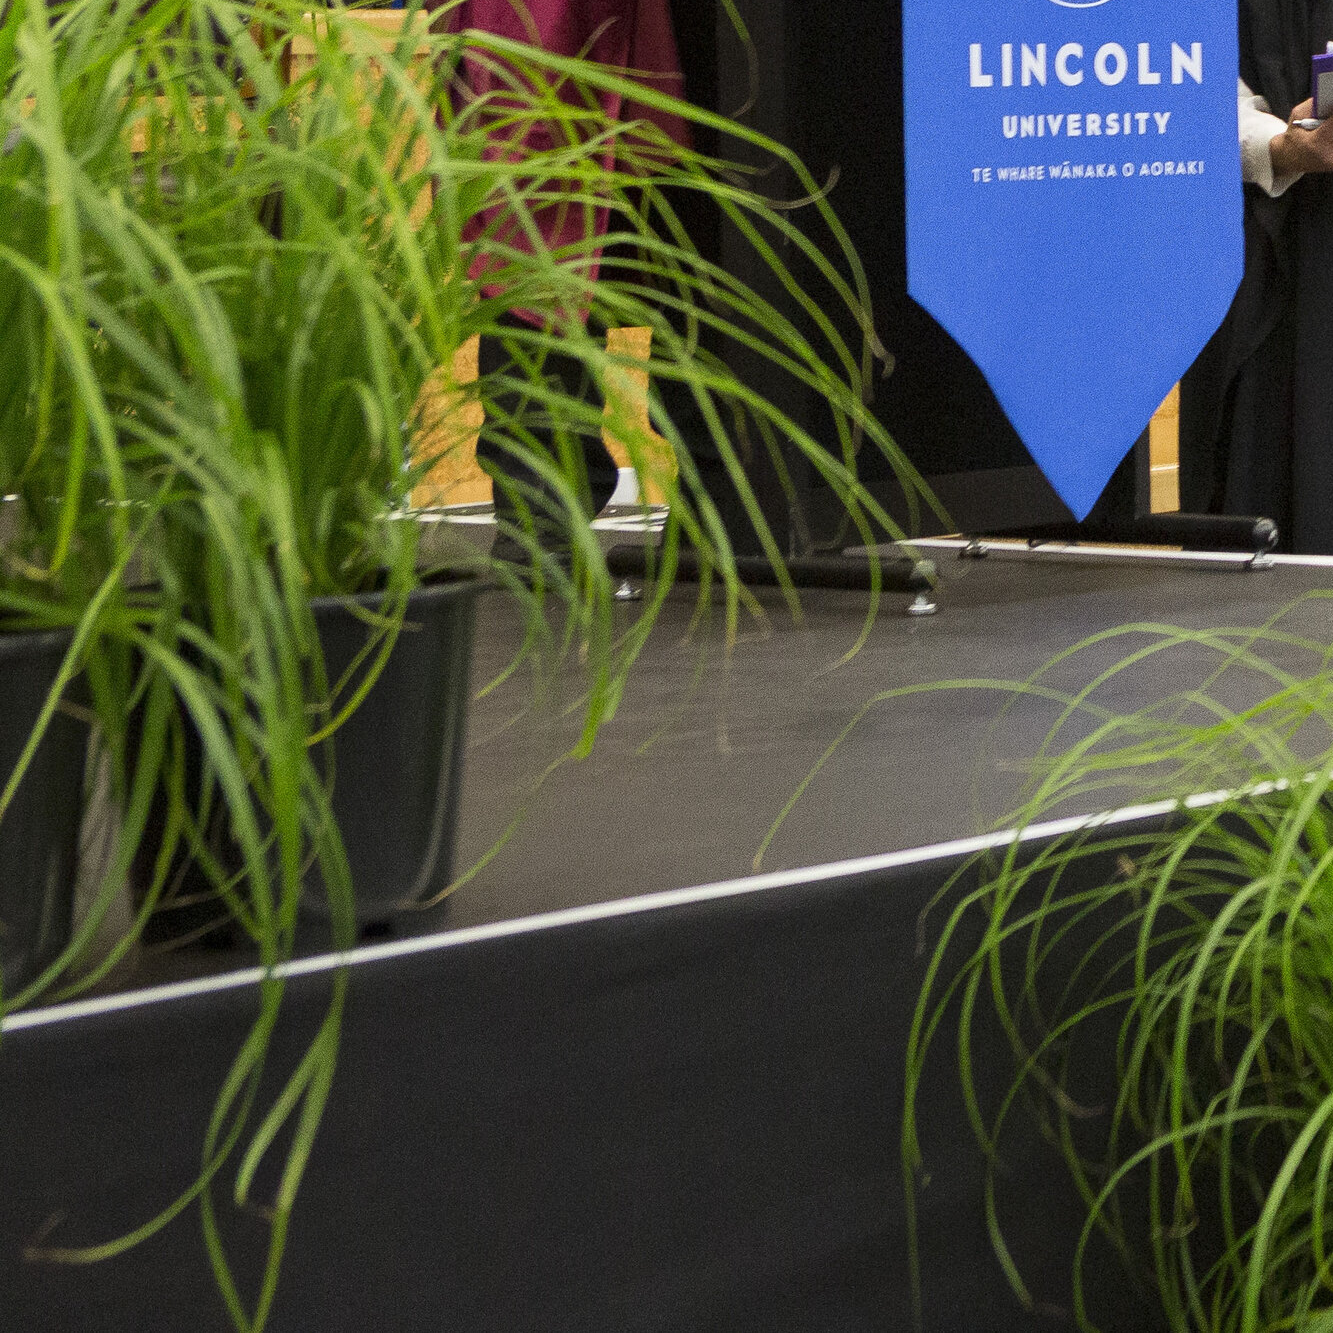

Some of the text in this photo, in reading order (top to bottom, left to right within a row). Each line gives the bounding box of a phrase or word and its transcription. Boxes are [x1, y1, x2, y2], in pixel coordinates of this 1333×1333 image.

[969, 42, 1203, 88] LINCOLN
[1002, 111, 1172, 139] UNIVERSITY
[971, 167, 993, 183] TE
[996, 165, 1045, 182] WHARE
[1139, 160, 1205, 176] AORAKI
